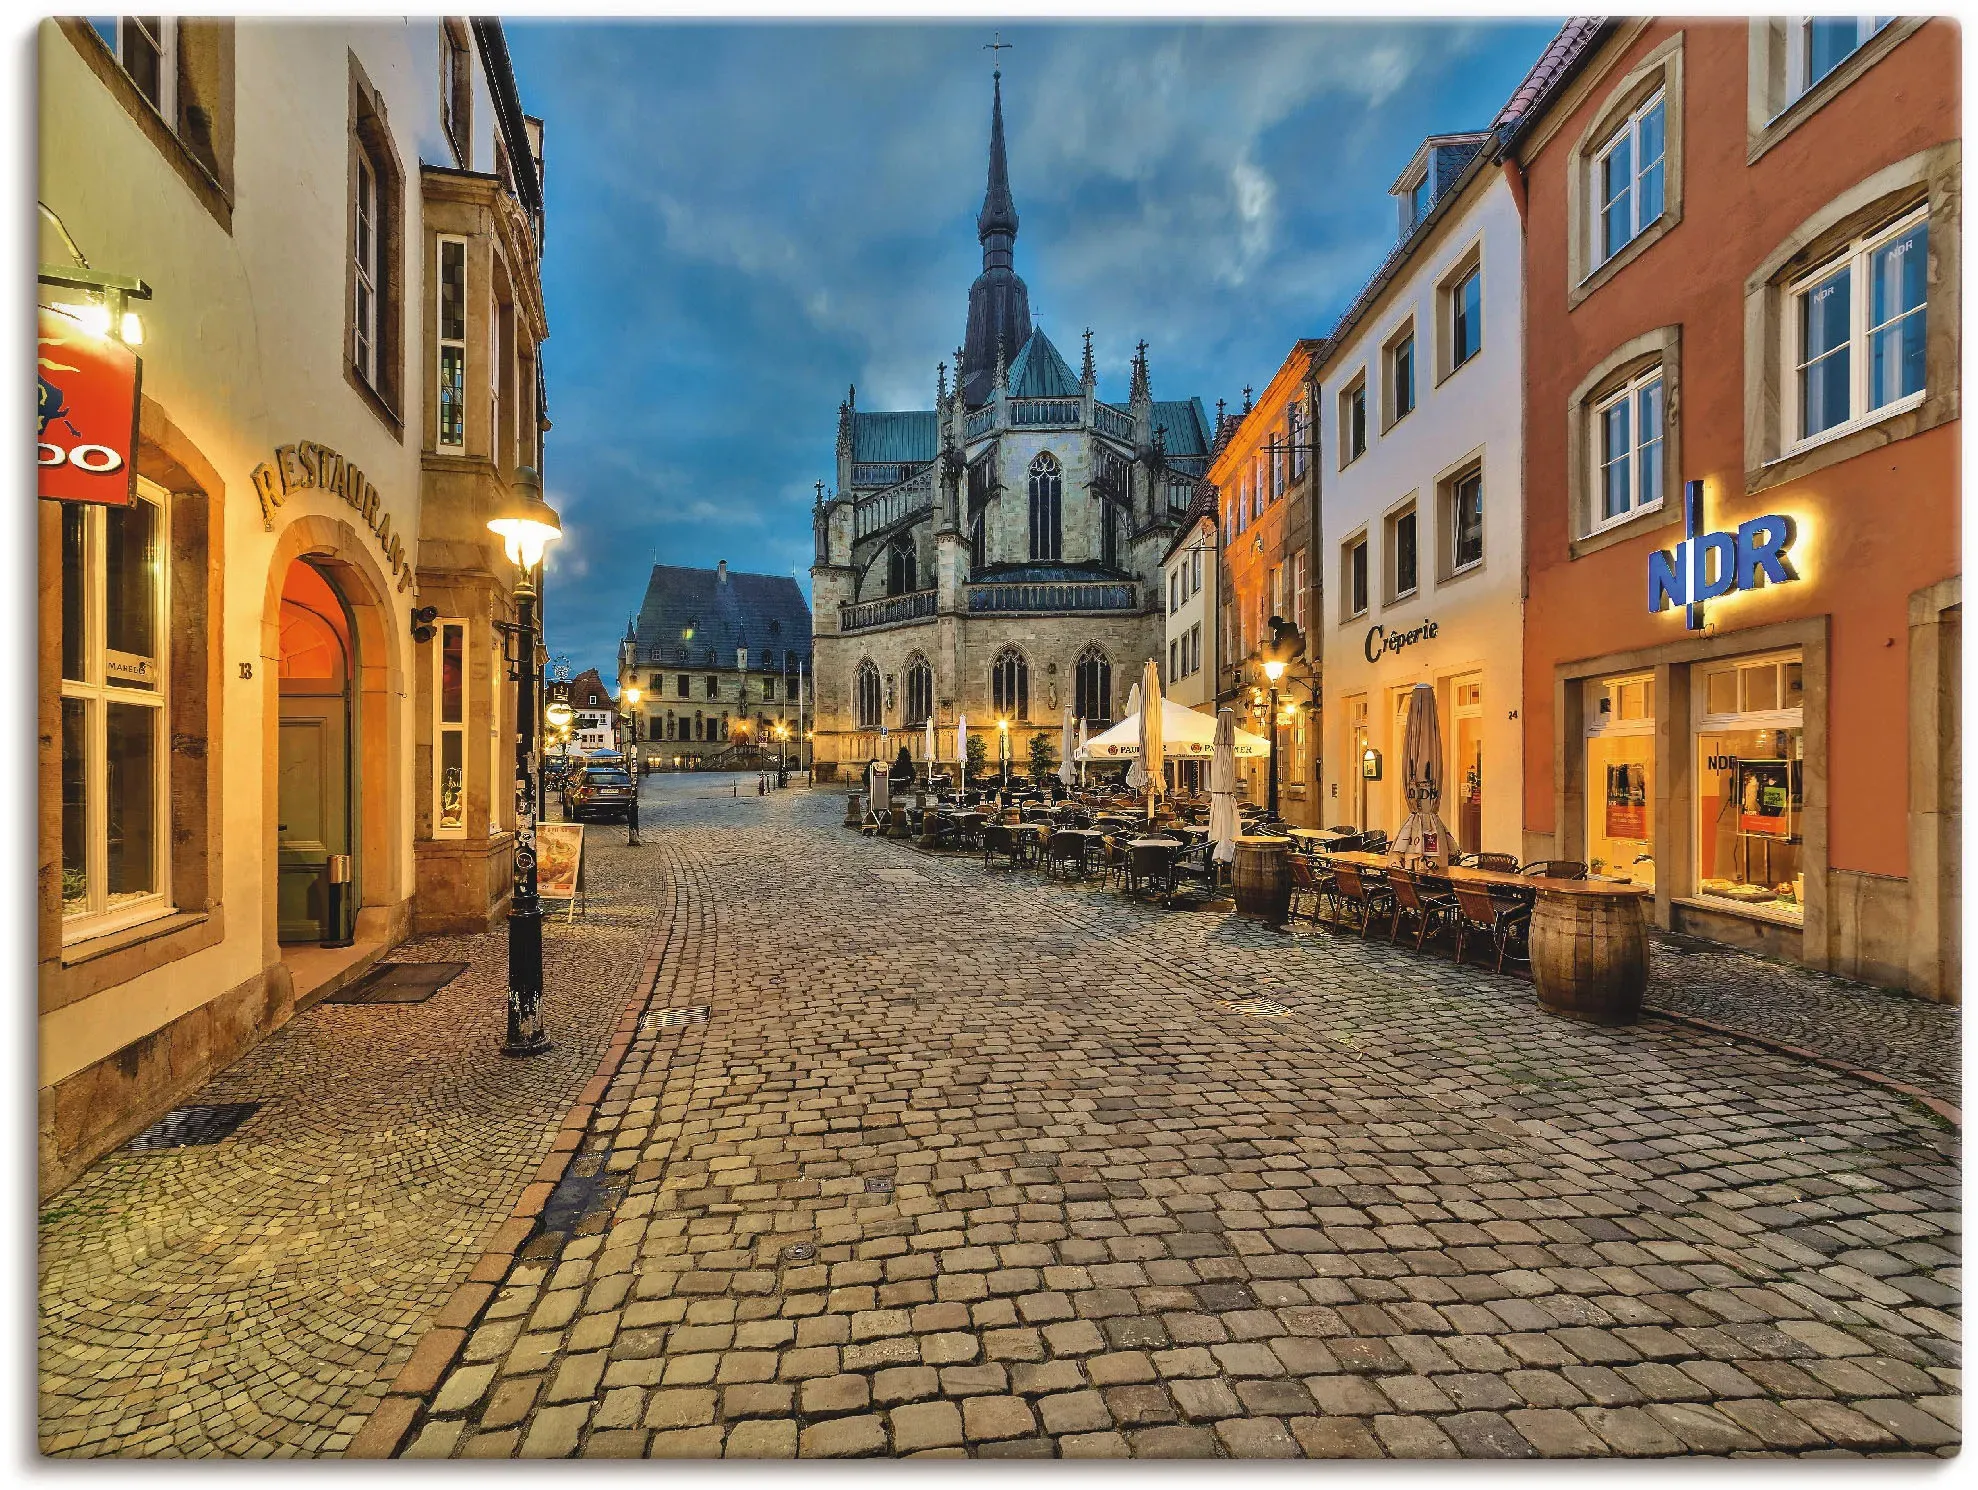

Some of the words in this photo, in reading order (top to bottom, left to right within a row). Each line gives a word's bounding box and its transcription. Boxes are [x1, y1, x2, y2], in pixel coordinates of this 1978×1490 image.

[1888, 239, 1913, 262] NDR
[1813, 286, 1835, 304] NDR
[250, 440, 414, 594] RESTAURANT
[1648, 513, 1798, 614] NDR
[1364, 618, 1439, 664] Crêperie
[238, 662, 252, 680] 13
